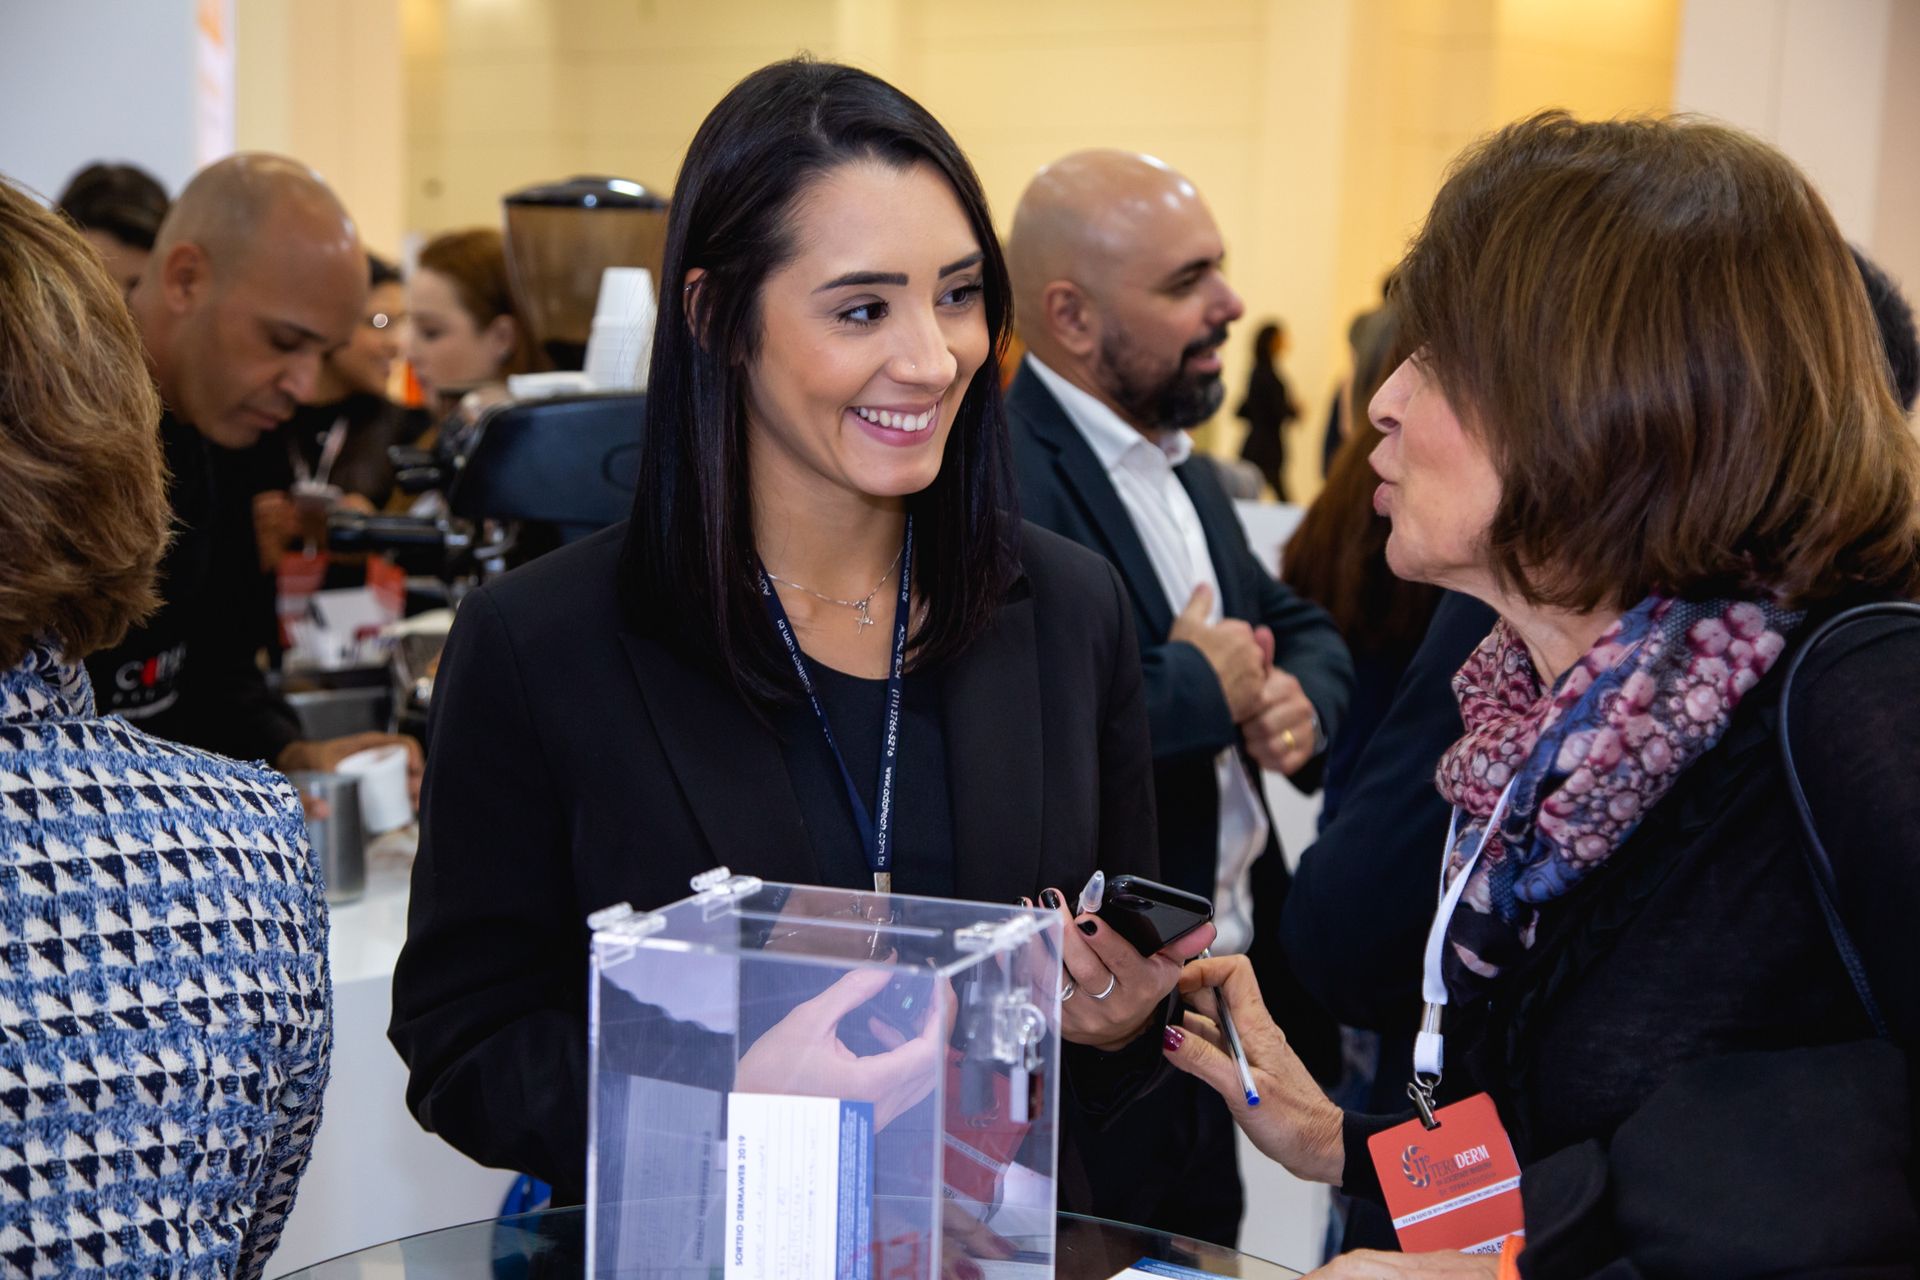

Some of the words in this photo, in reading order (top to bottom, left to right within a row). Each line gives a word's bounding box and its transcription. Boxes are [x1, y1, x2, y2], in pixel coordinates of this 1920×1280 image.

[886, 708, 899, 757] 3766-5216
[737, 1135, 747, 1160] 2019
[736, 1164, 746, 1222] DERMAWEB
[735, 1224, 745, 1266] SORTEIO
